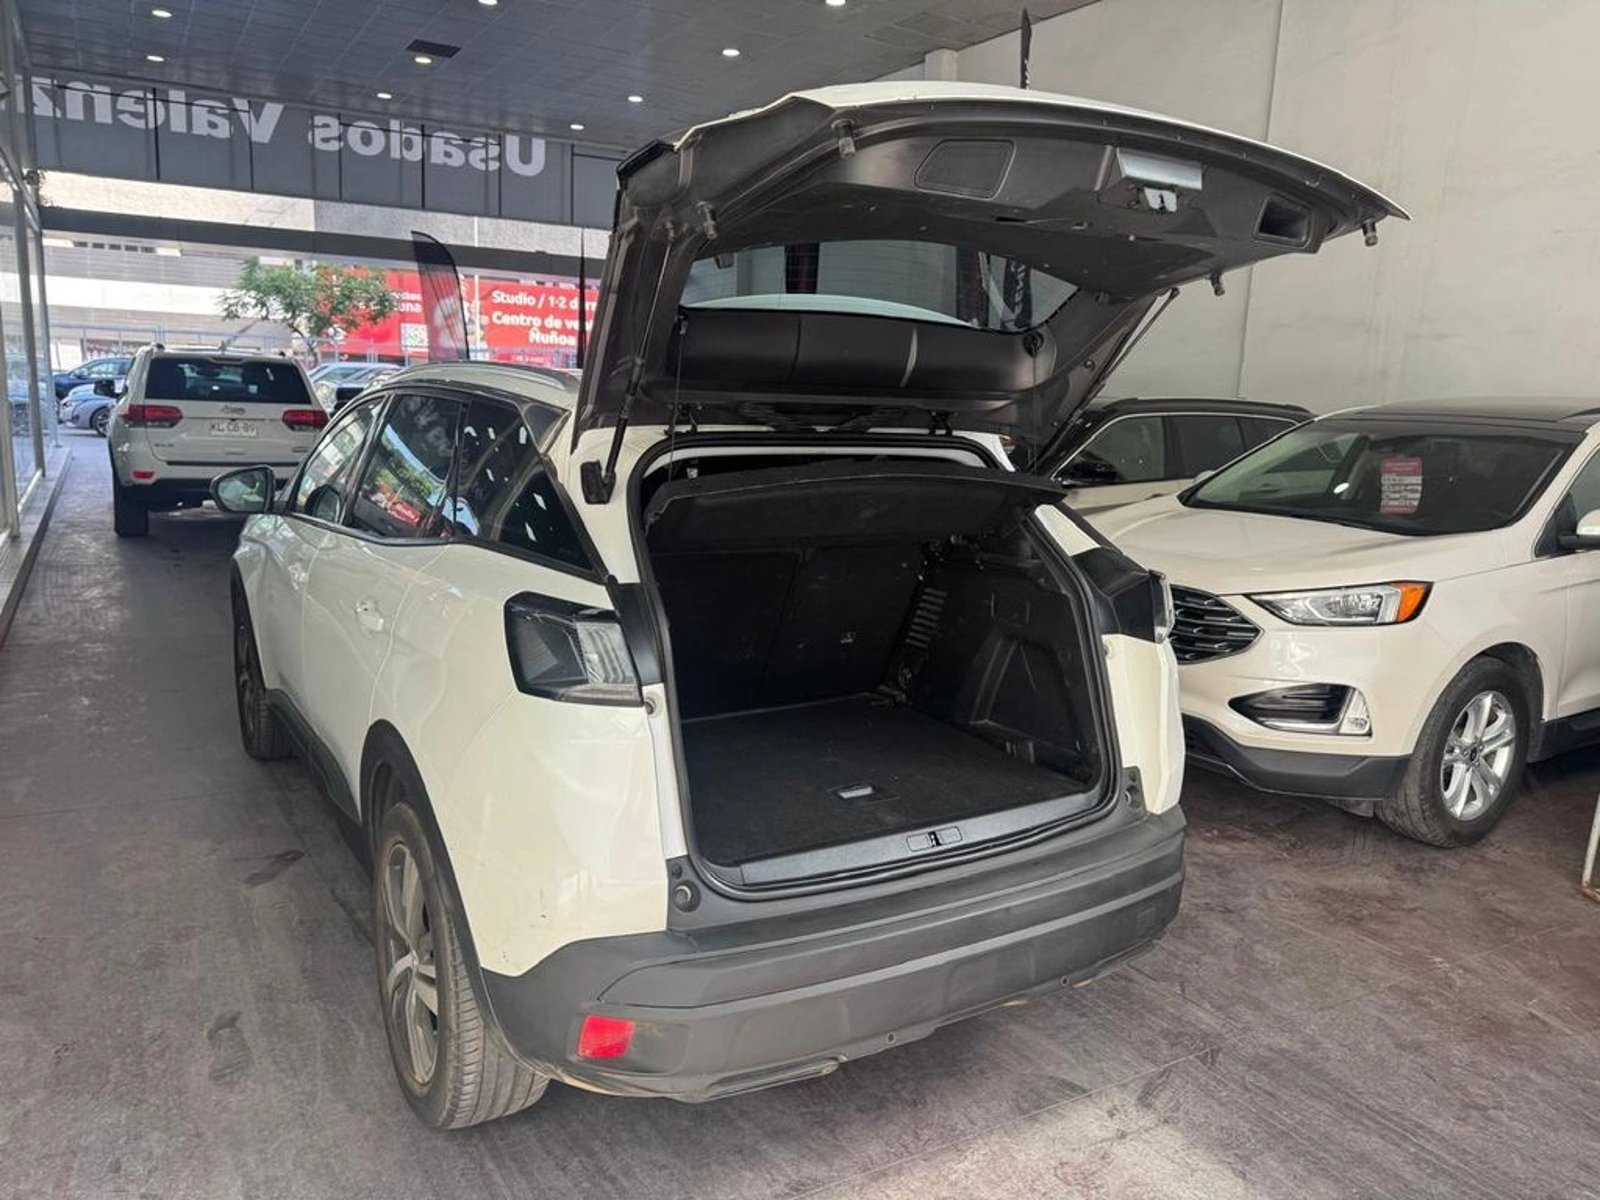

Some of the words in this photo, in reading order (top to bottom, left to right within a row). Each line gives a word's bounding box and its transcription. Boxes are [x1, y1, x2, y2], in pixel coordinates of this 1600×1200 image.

[492, 290, 536, 307] Studio
[538, 294, 546, 309] /
[492, 311, 541, 328] Centro
[544, 315, 563, 329] de
[529, 327, 576, 346] Ñuñoa
